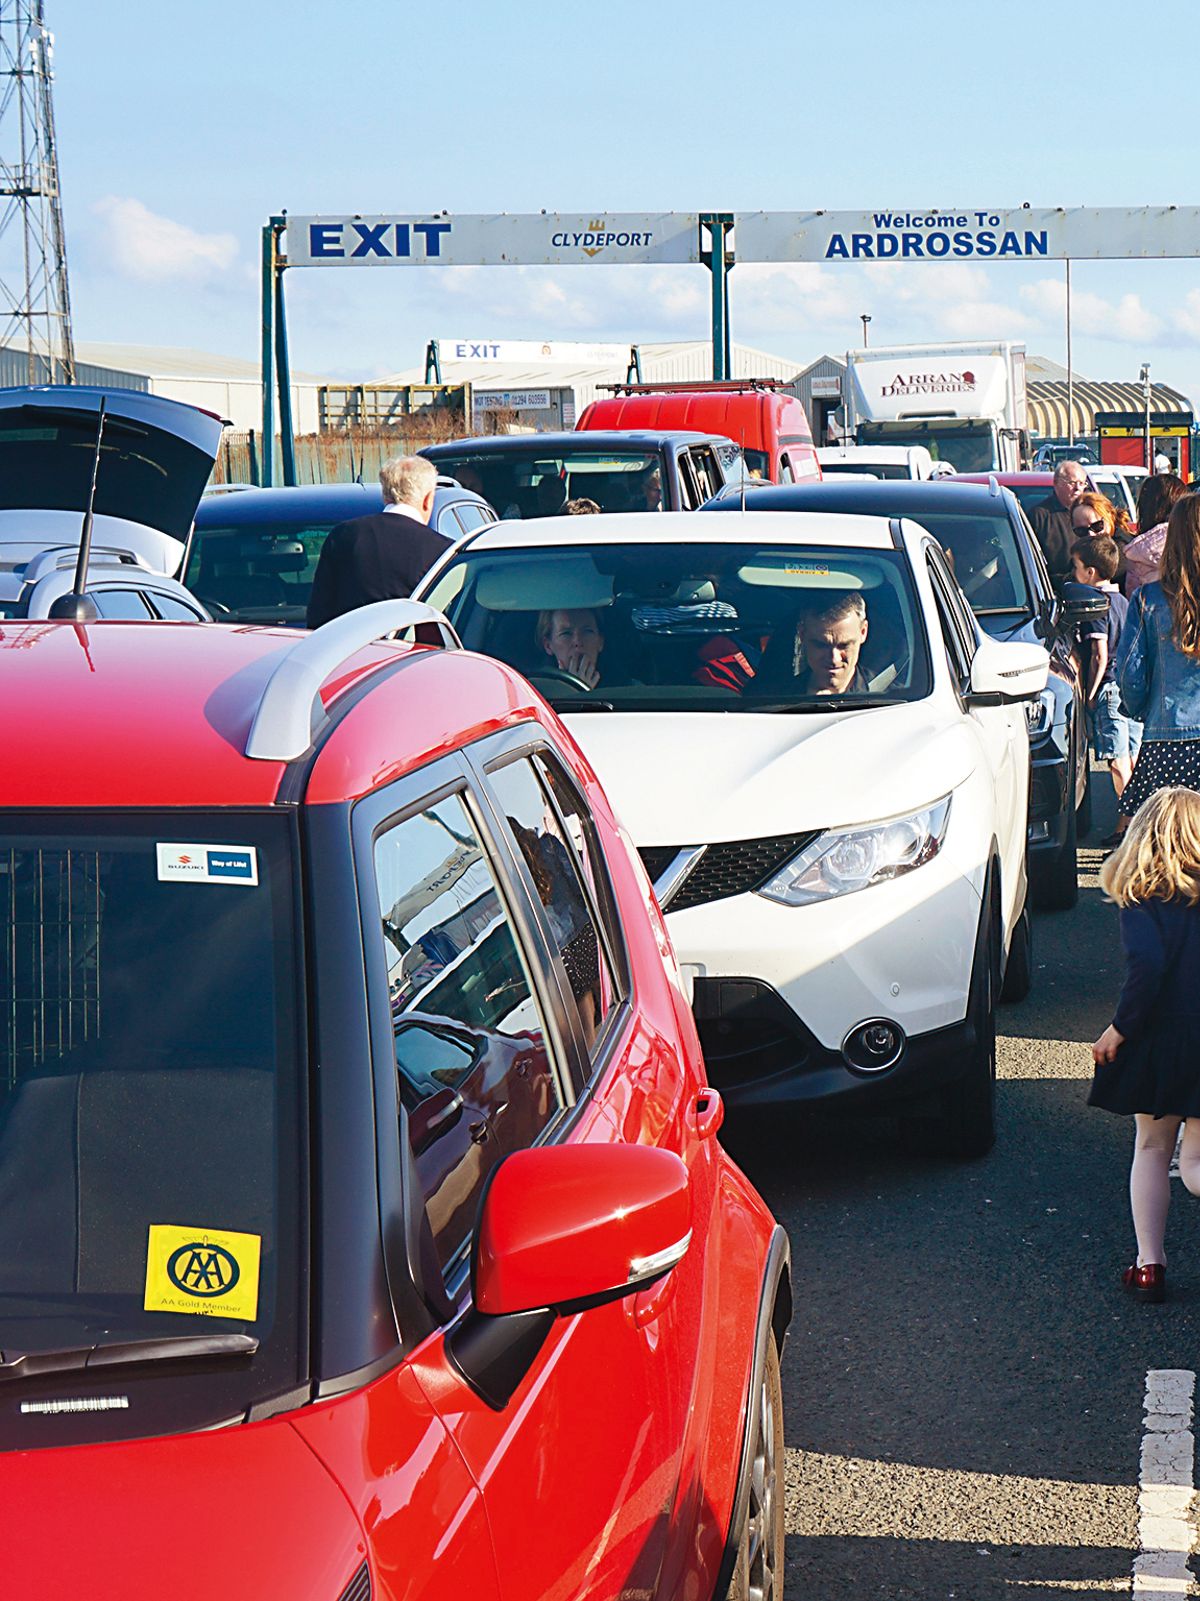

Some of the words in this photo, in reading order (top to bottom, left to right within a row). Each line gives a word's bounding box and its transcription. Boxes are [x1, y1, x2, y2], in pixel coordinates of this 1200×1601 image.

[873, 213, 967, 229] Welcome
[974, 212, 1000, 227] To
[309, 223, 452, 257] EXIT
[552, 232, 653, 247] CLYDEPORT
[825, 231, 1048, 258] ARDROSSAN
[456, 344, 501, 358] EXIT
[211, 859, 225, 868] Way
[233, 860, 247, 868] Life!
[160, 1298, 175, 1306] AA
[178, 1299, 200, 1308] Gold
[202, 1302, 242, 1313] Member
